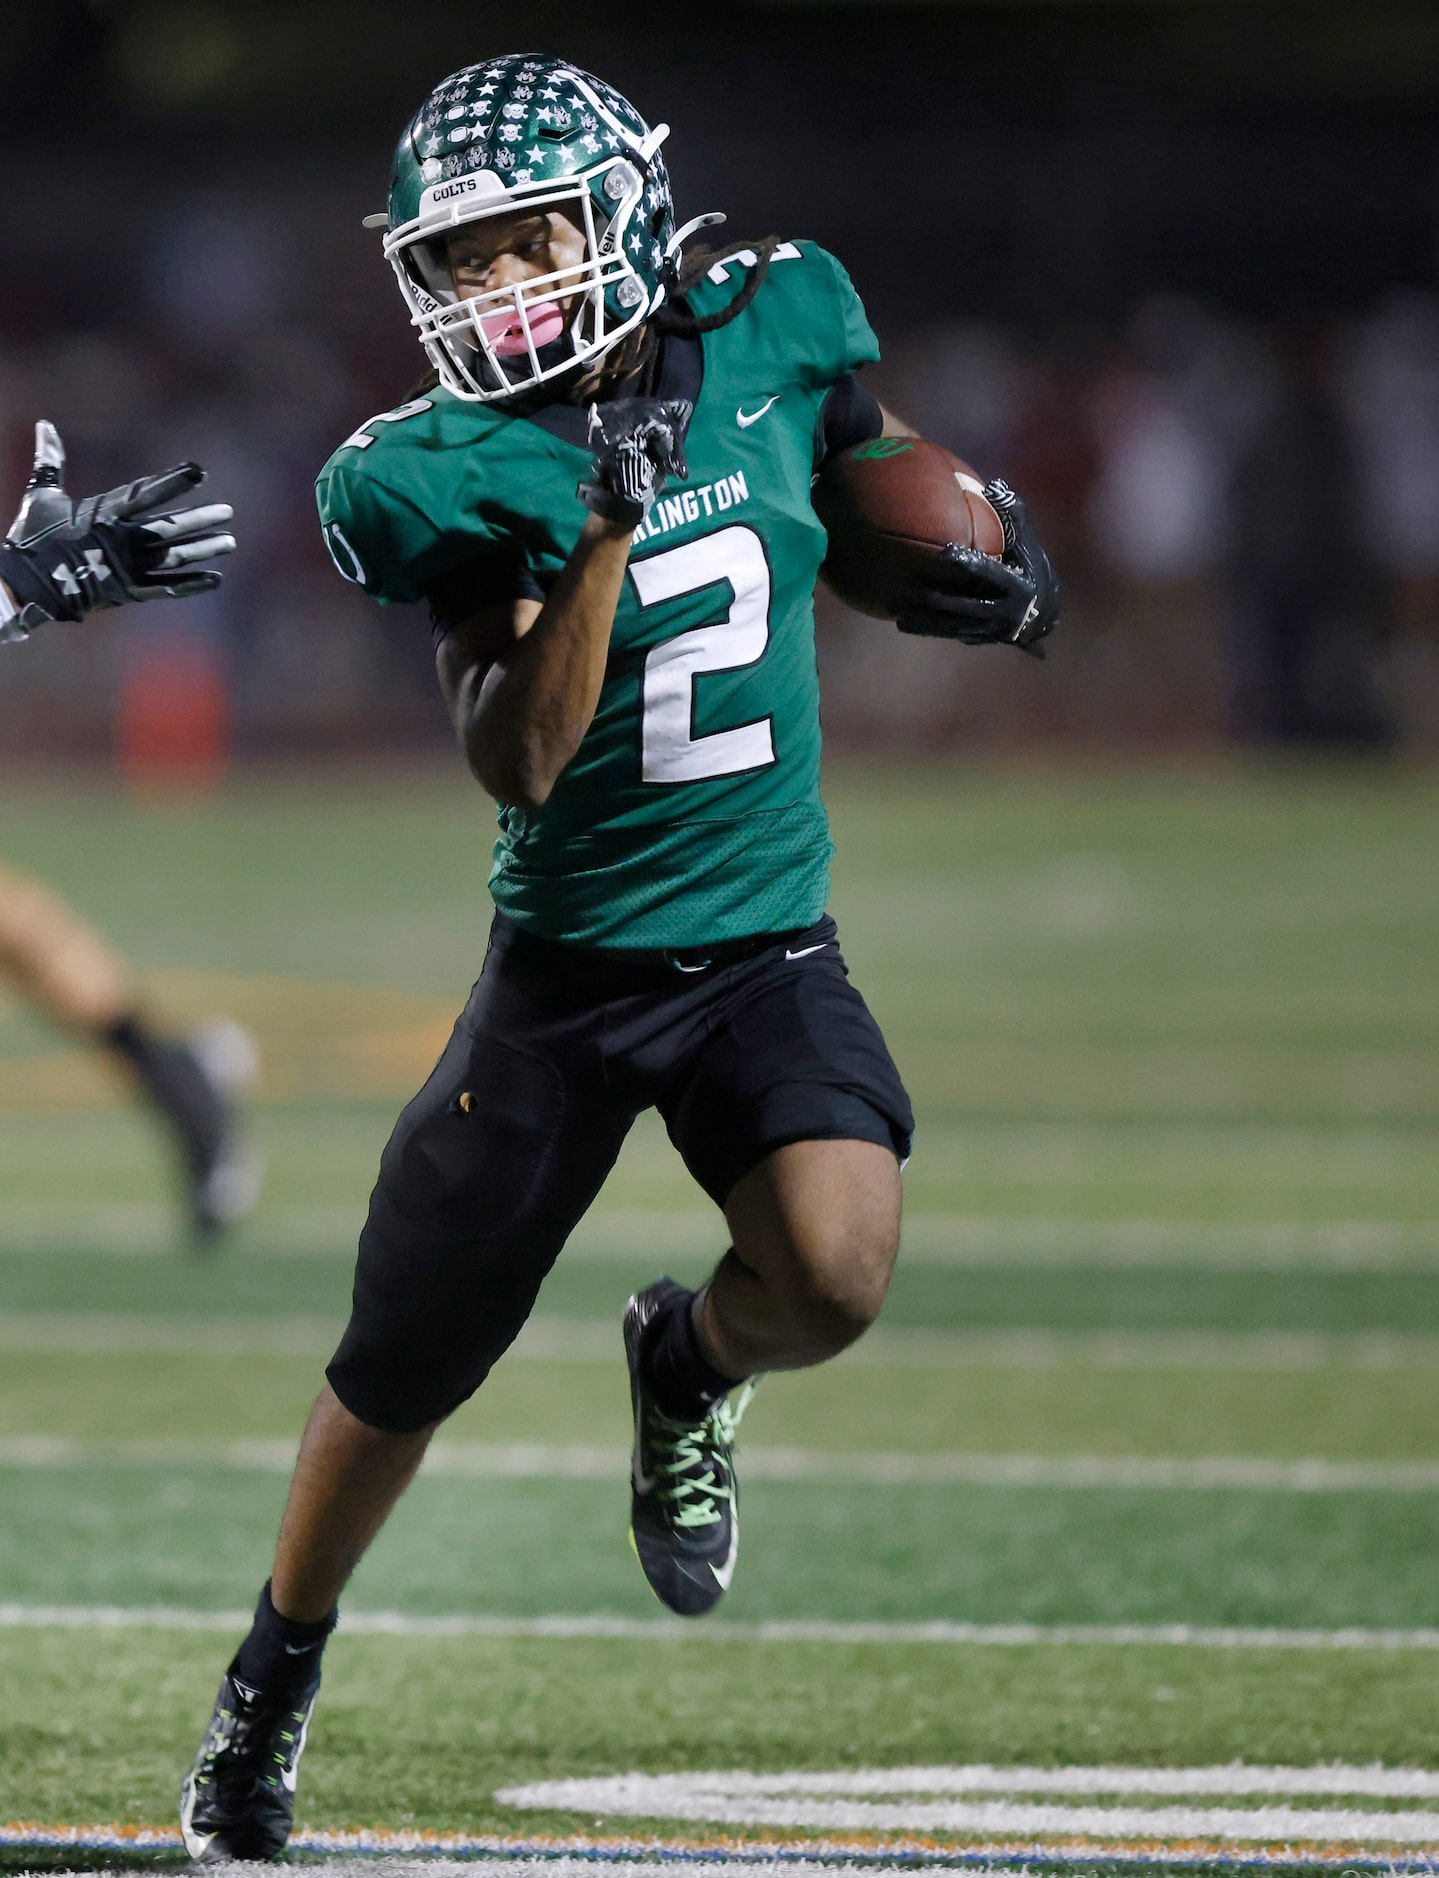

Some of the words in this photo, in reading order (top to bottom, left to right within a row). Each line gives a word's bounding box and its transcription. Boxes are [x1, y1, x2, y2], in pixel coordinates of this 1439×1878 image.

[433, 179, 477, 202] COLTS
[630, 469, 750, 546] LINGTON
[627, 522, 780, 783] 2
